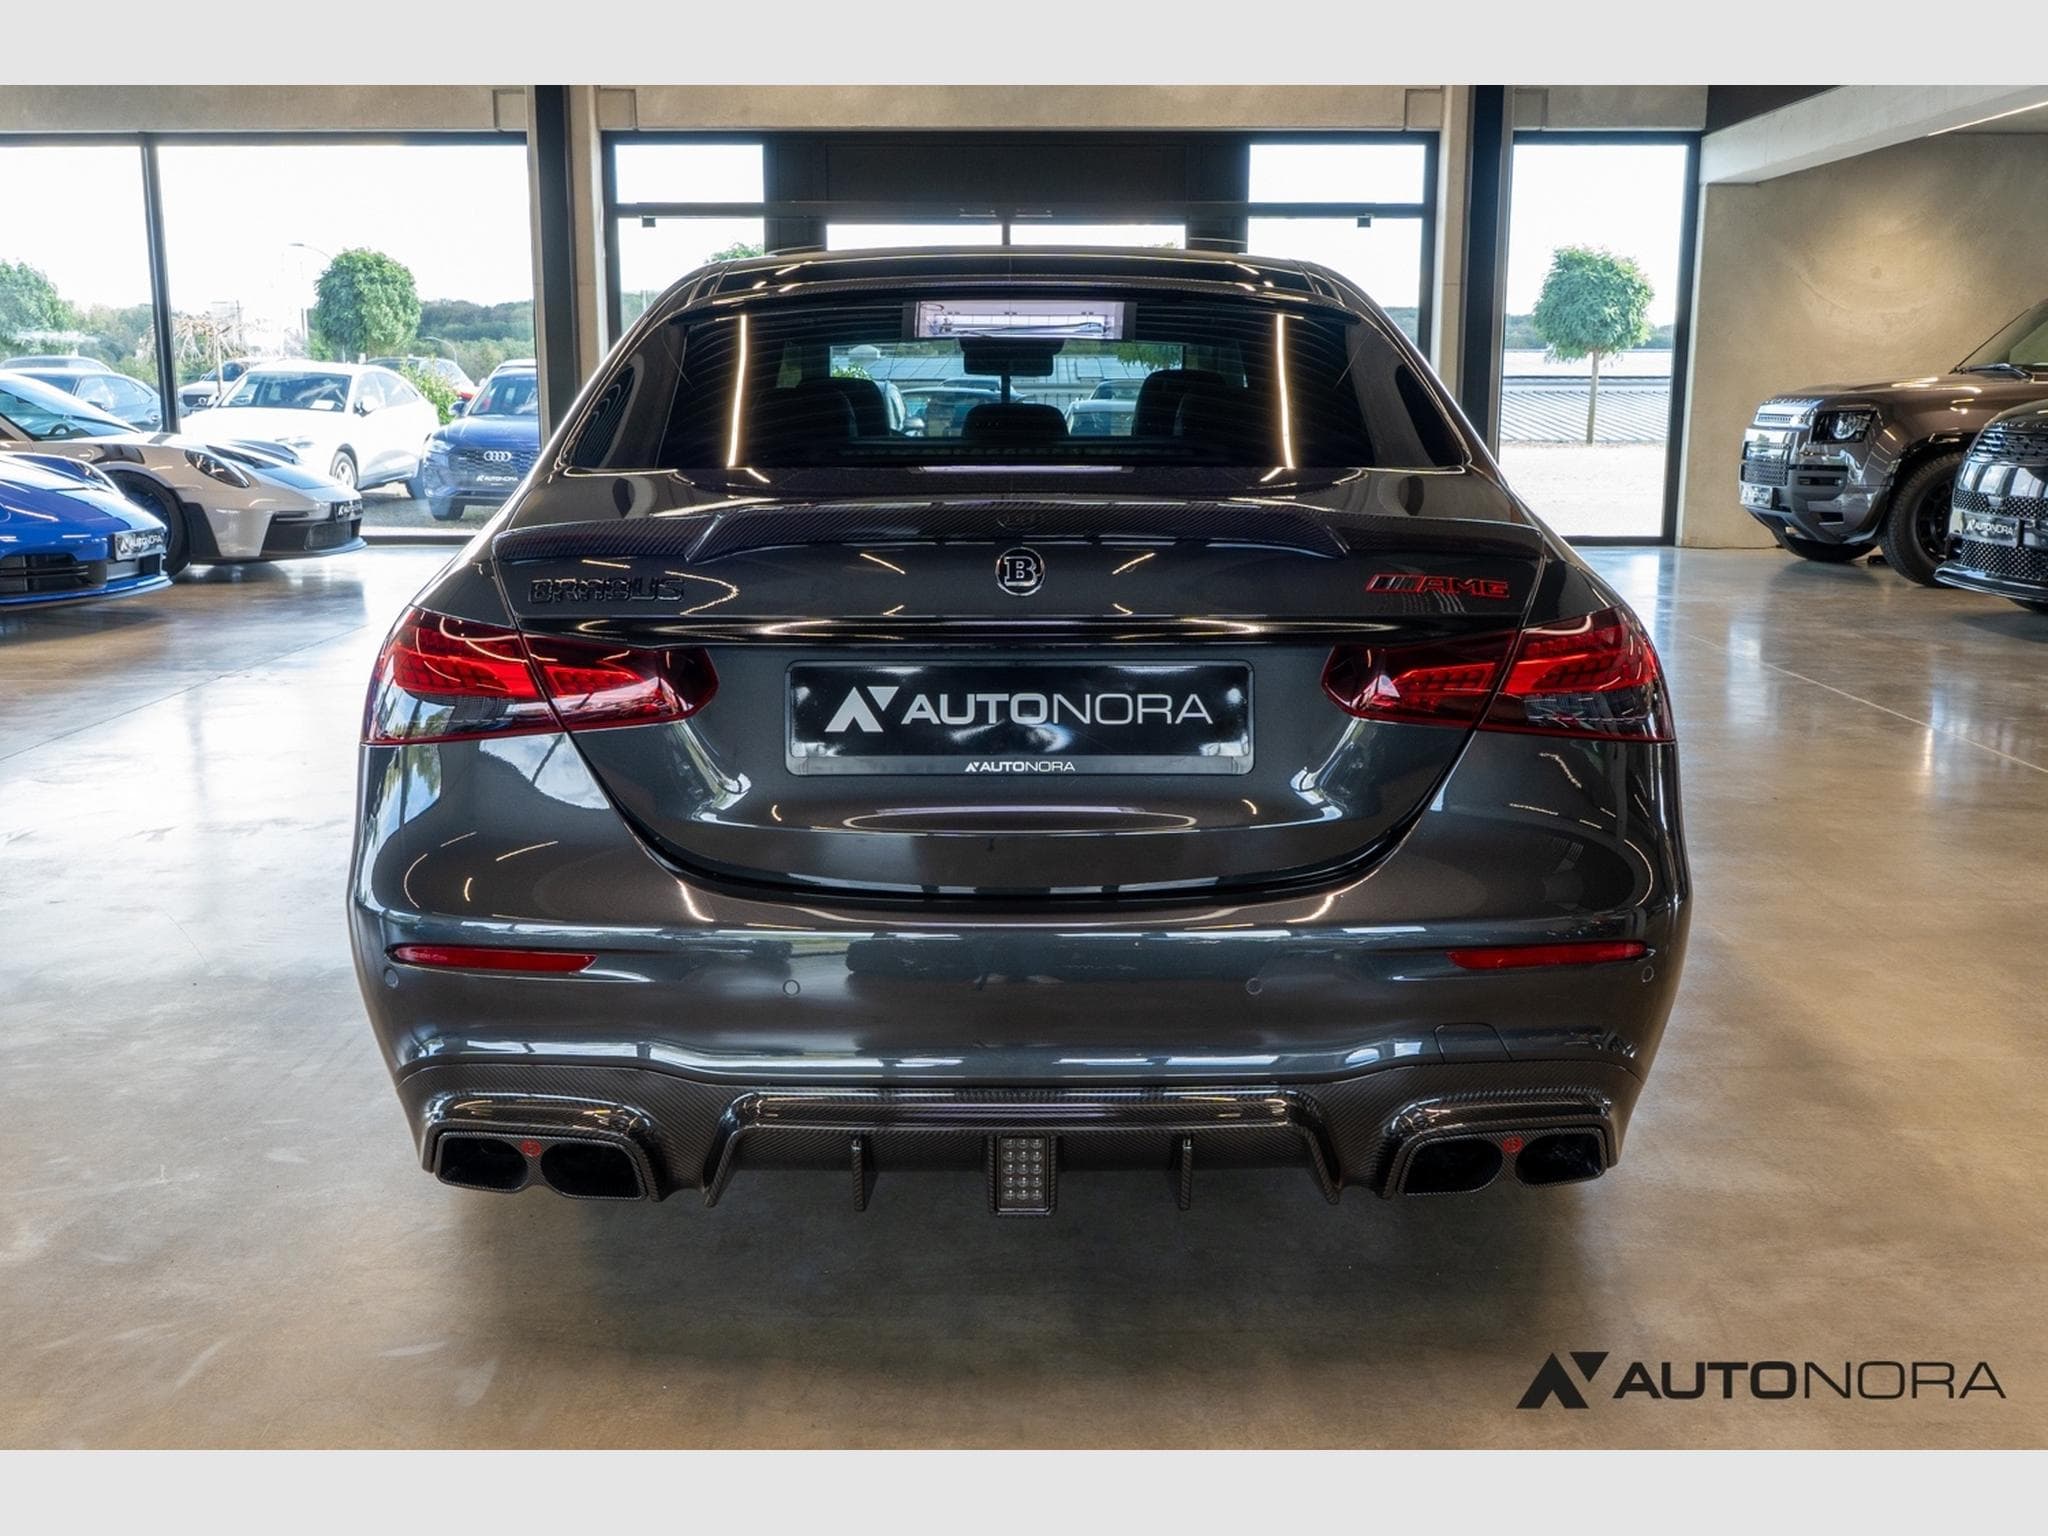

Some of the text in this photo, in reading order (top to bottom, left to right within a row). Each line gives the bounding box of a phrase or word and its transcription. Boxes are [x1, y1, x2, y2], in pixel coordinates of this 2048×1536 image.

[1974, 522, 2014, 536] AUTONORA
[1004, 556, 1037, 586] B
[901, 693, 1213, 725] AUTONORA
[979, 761, 1076, 772] AUTONORA
